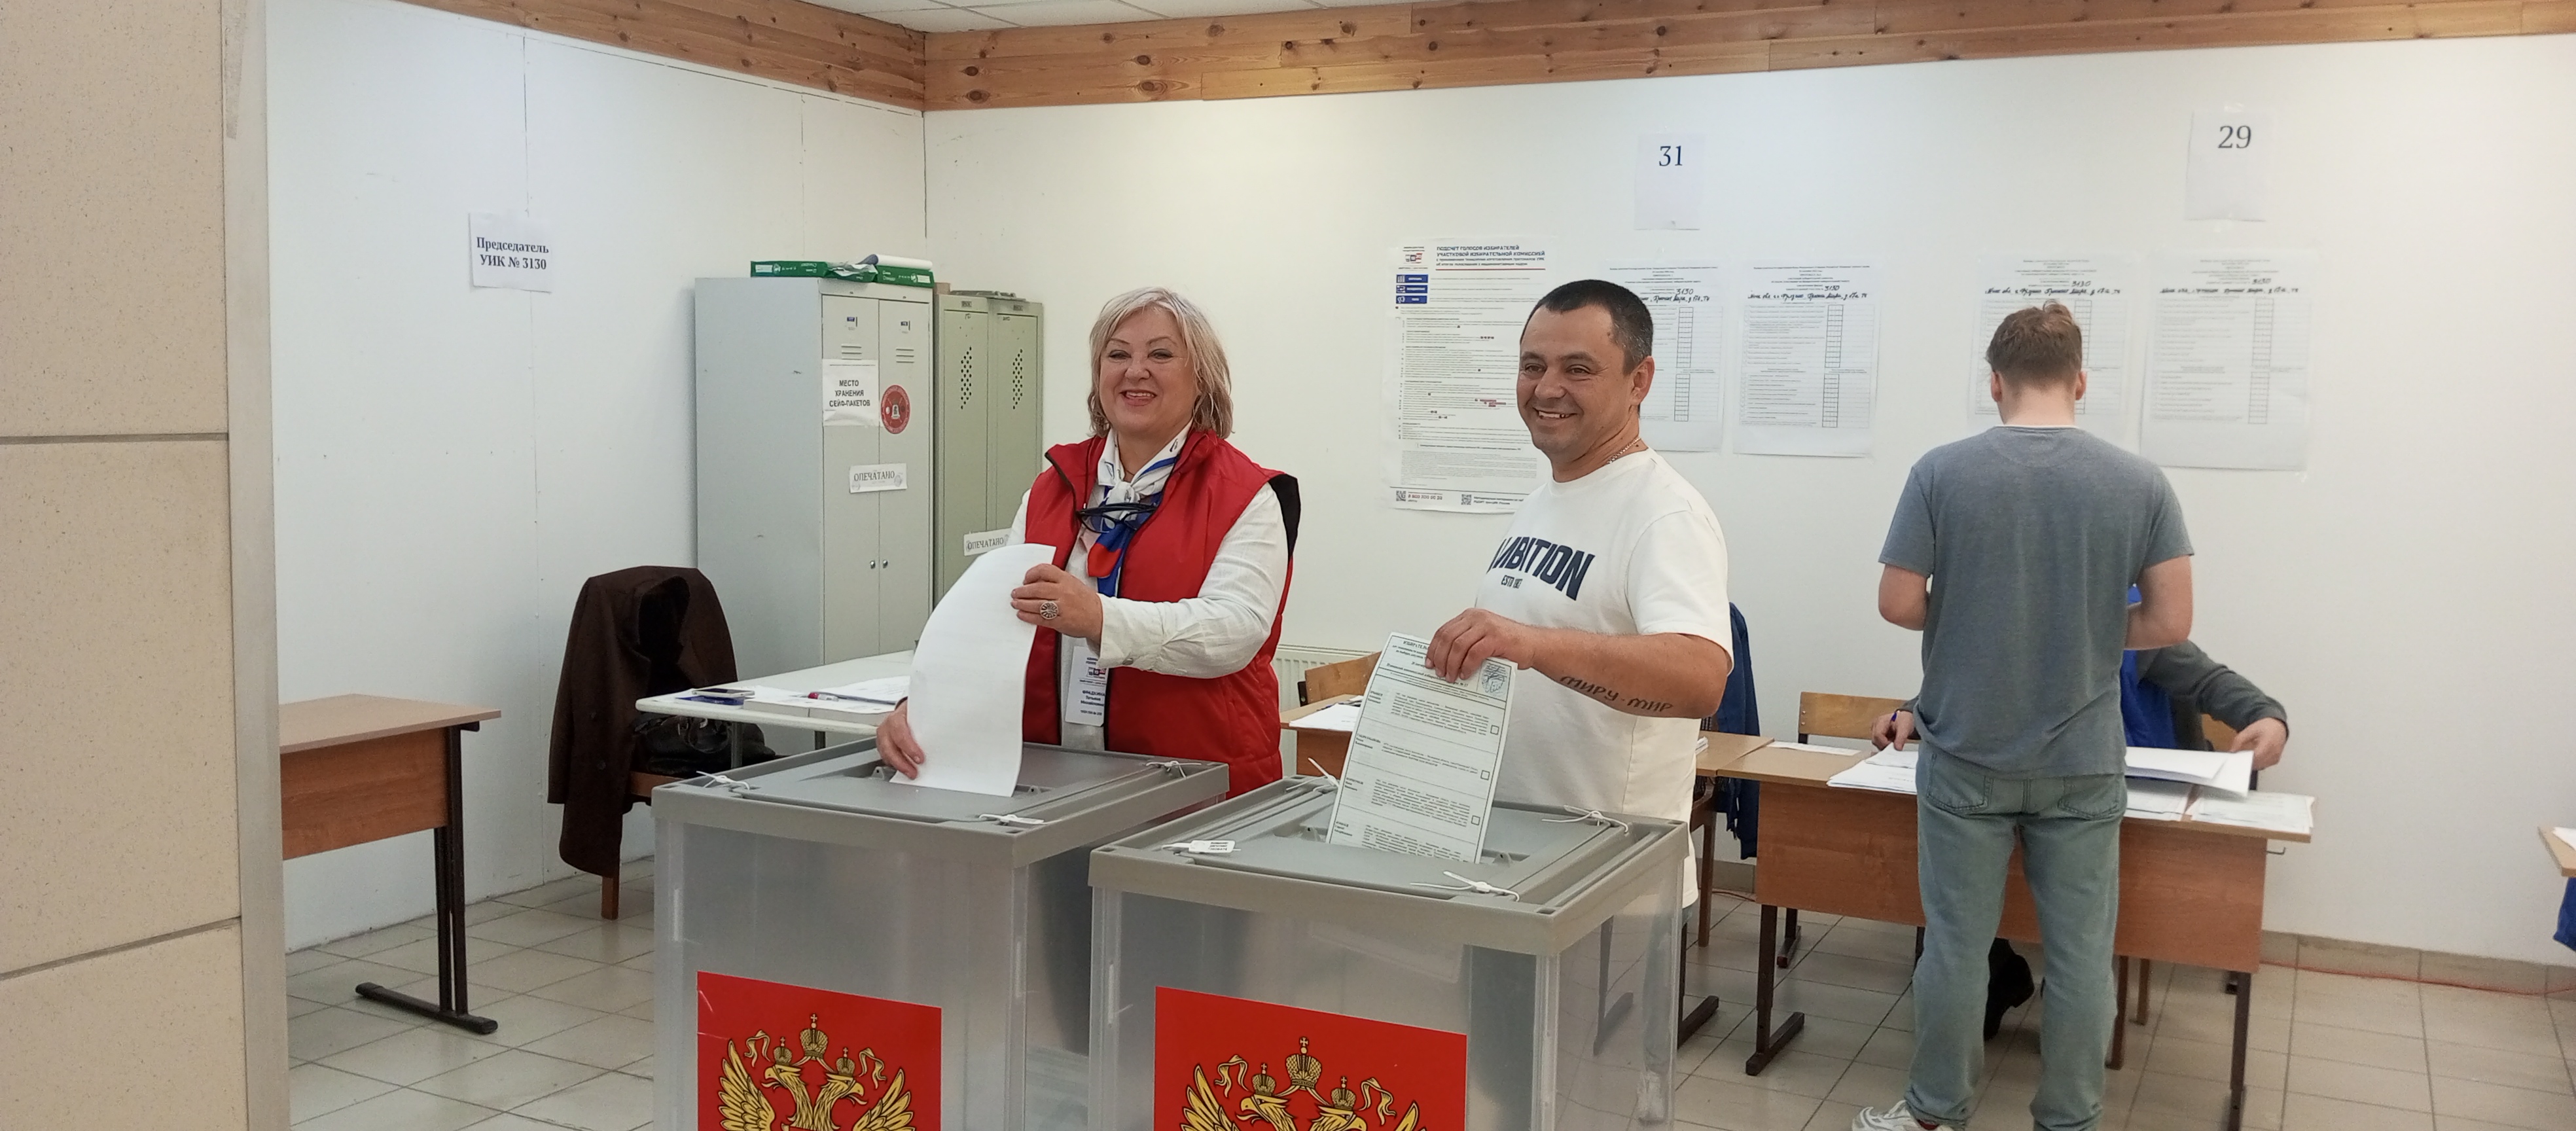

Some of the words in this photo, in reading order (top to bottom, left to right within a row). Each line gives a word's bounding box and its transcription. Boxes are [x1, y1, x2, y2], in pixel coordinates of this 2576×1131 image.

[2217, 125, 2251, 149] 29
[1659, 145, 1683, 166] 31
[476, 236, 549, 253] Председатель
[480, 254, 506, 267] УИК
[508, 256, 520, 268] №
[522, 257, 546, 270] 3130
[829, 399, 870, 407] СЕЙФ-ПАКЕТОВ
[853, 471, 895, 482] ОПЕЧАТАНО
[967, 537, 1004, 550] ОПЕЧАТАНО
